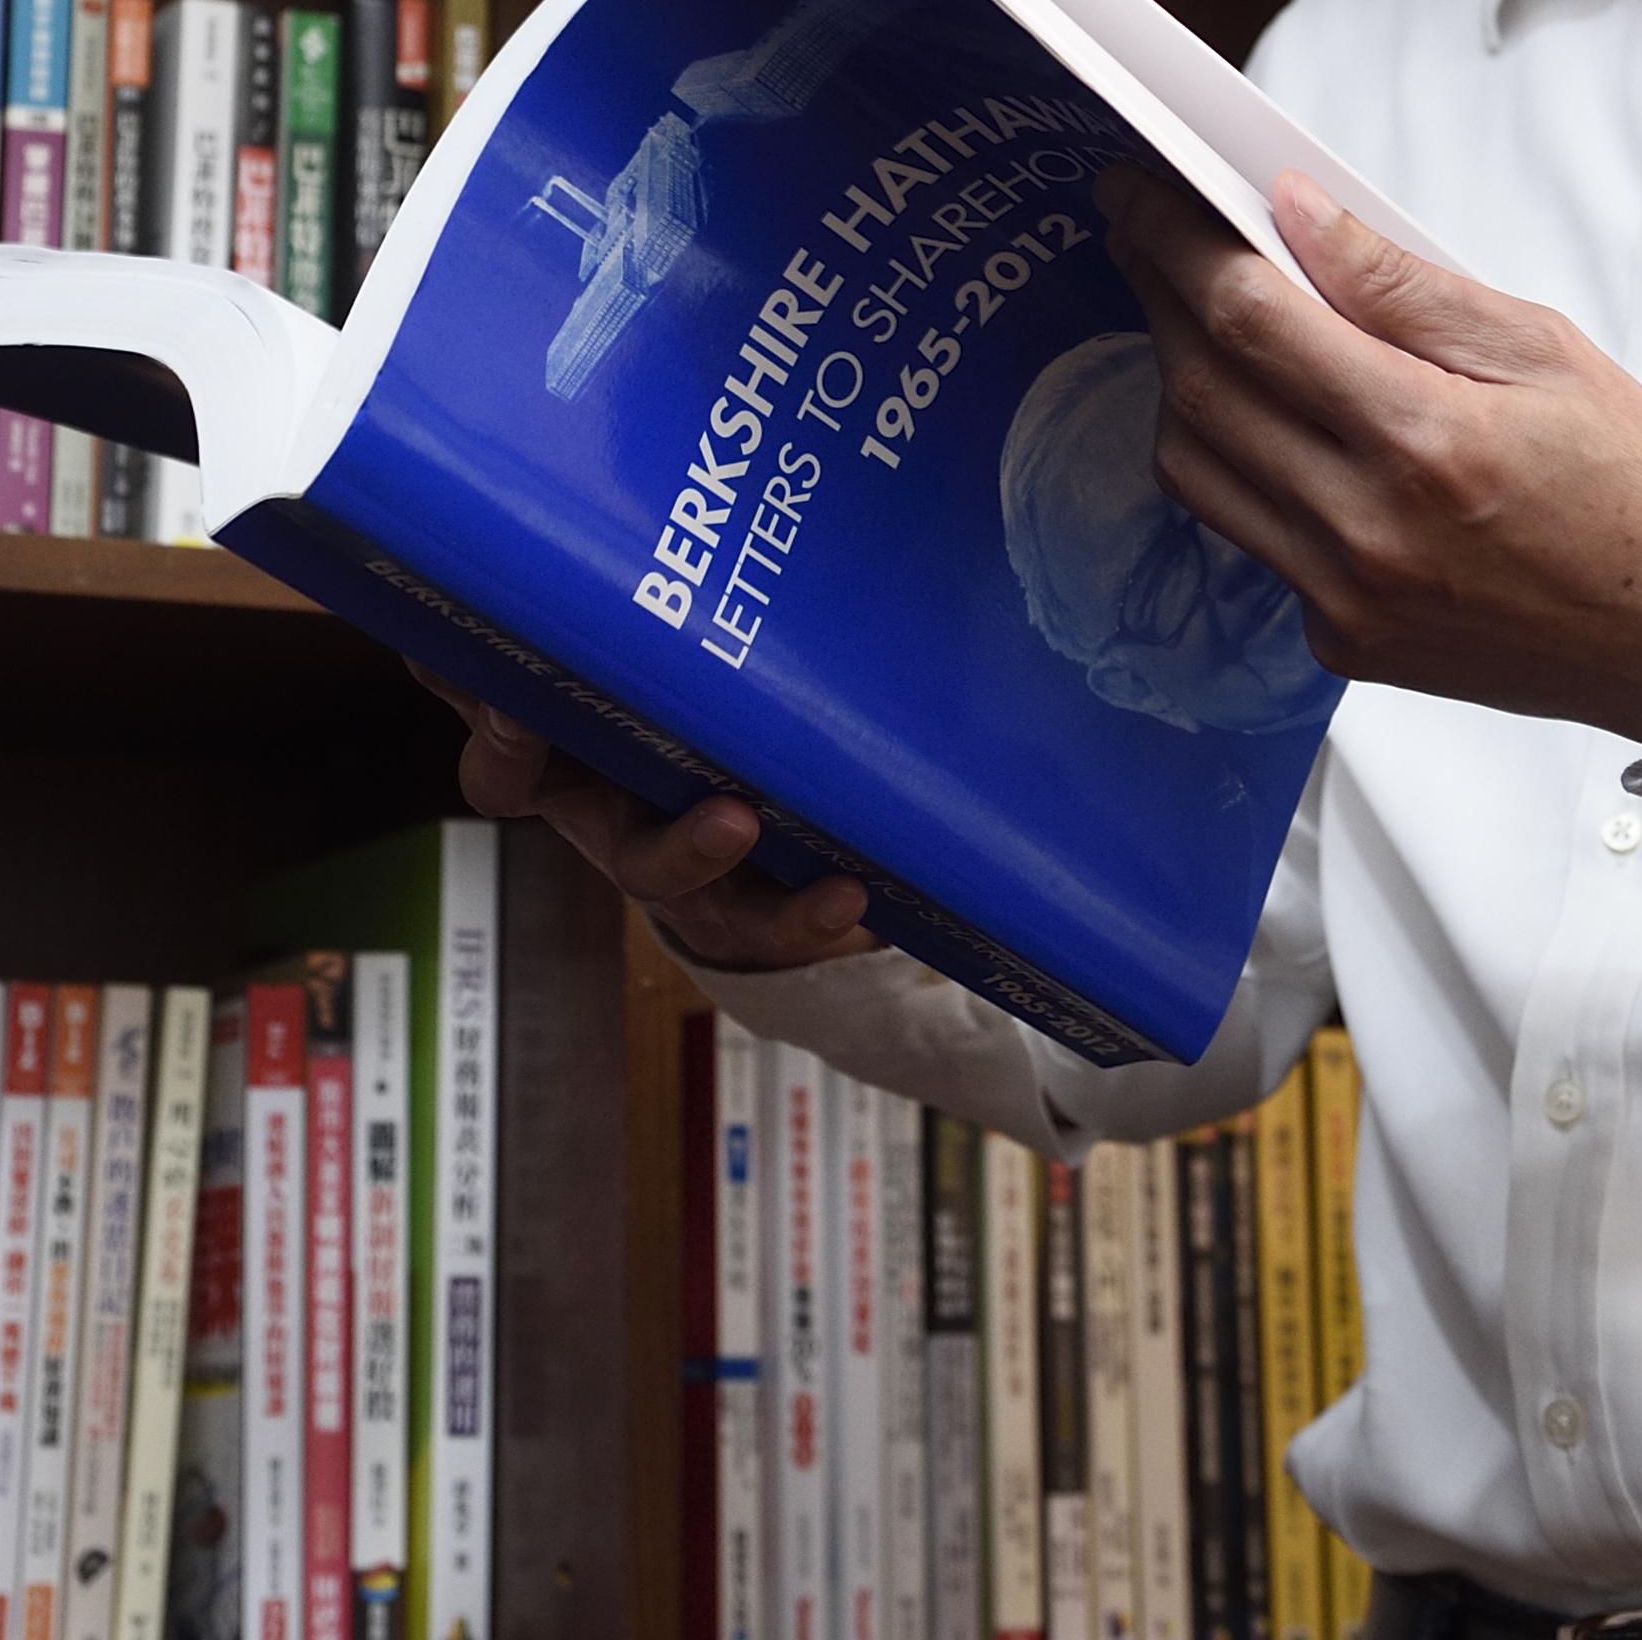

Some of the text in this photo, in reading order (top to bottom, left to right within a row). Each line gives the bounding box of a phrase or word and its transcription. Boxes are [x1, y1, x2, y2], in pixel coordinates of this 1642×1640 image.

[632, 247, 846, 631] BERKSHIRE
[860, 211, 1092, 470] 1965-2012
[363, 558, 558, 677] BERKSHIRE
[700, 441, 822, 671] LETTERS
[796, 350, 864, 433] TO
[980, 972, 1121, 1057] 1965-2012
